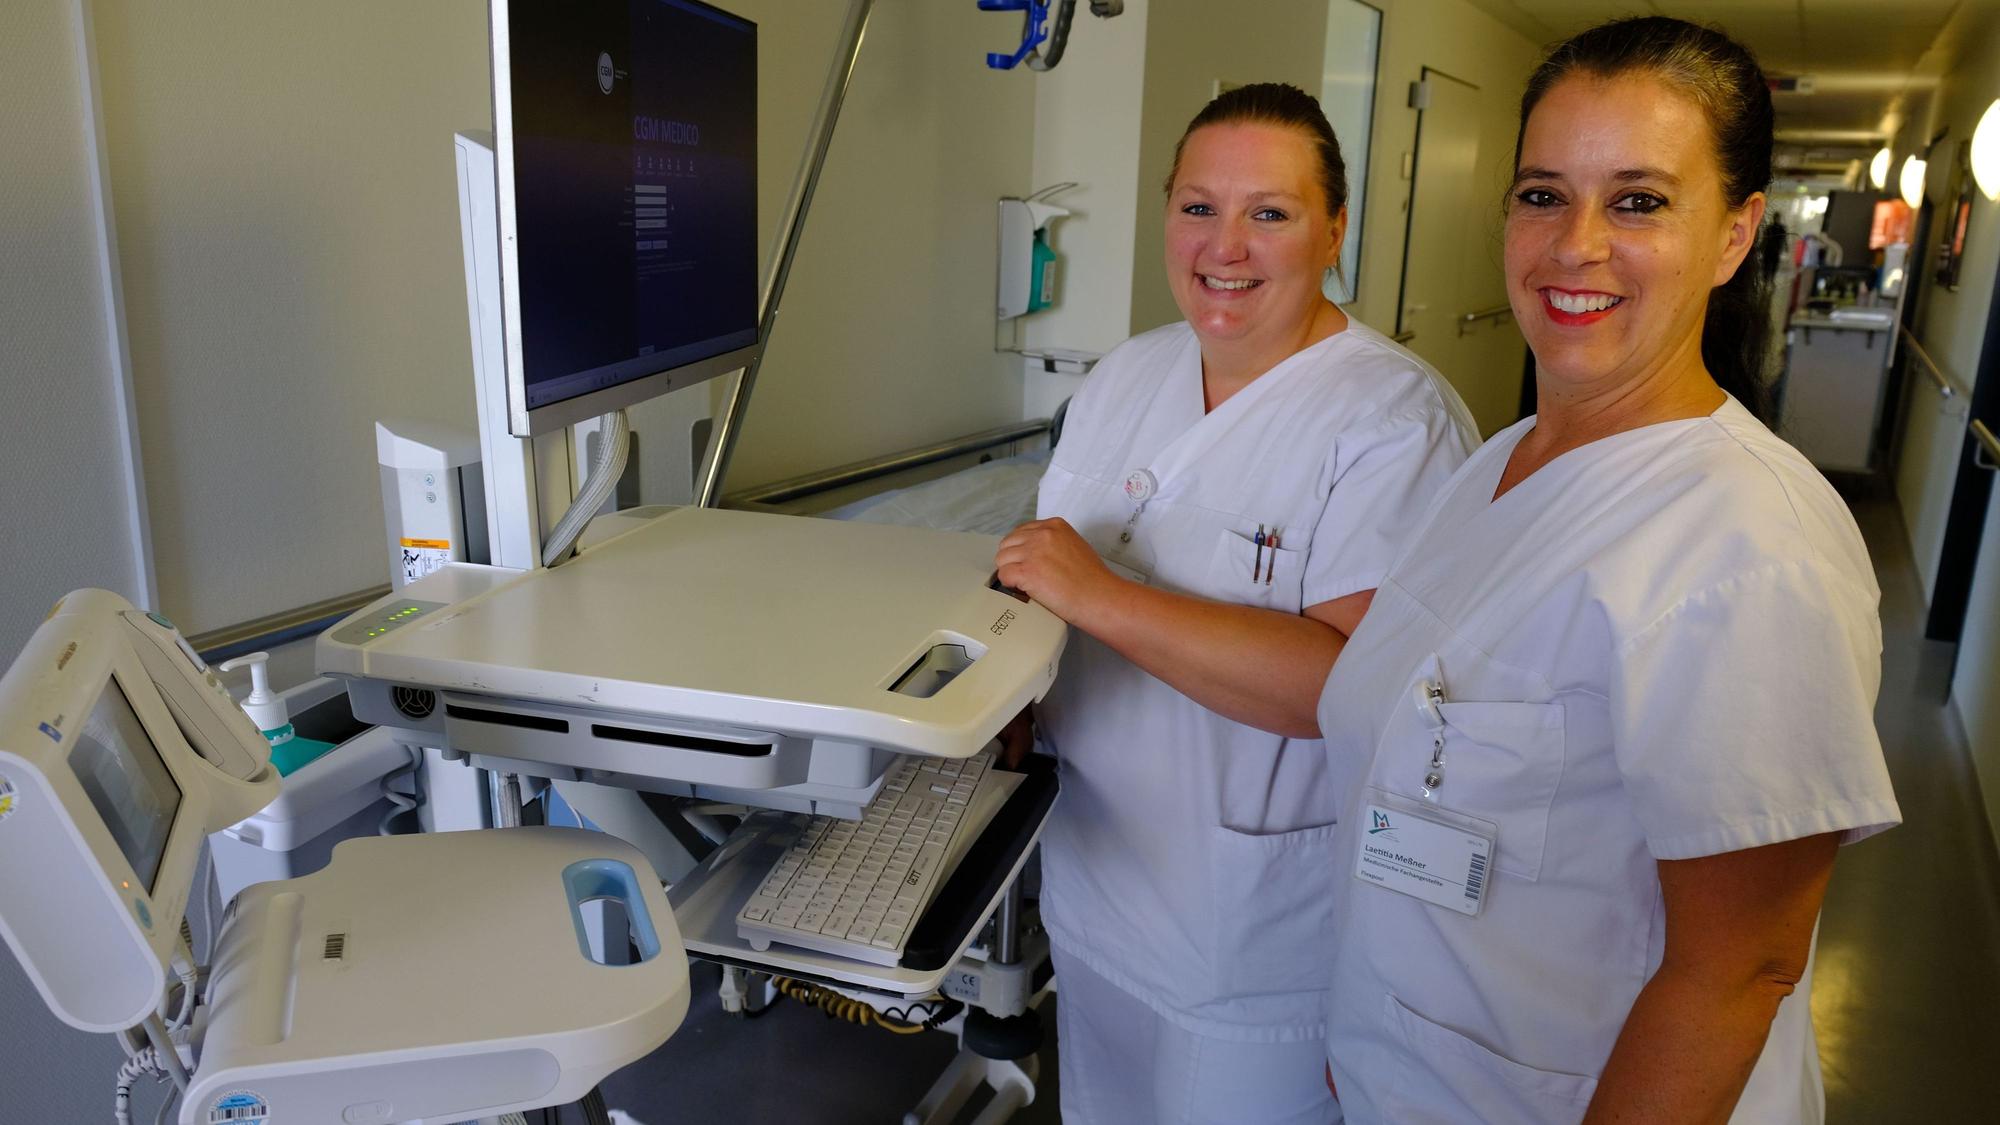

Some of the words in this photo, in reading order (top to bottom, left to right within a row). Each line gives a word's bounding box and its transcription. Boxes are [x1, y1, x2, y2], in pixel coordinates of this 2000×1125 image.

[634, 115, 659, 142] CGM
[661, 119, 699, 146] MEDICO
[1365, 844, 1394, 859] Laetitia
[1395, 853, 1427, 869] Meßner
[907, 870, 921, 886] GETT
